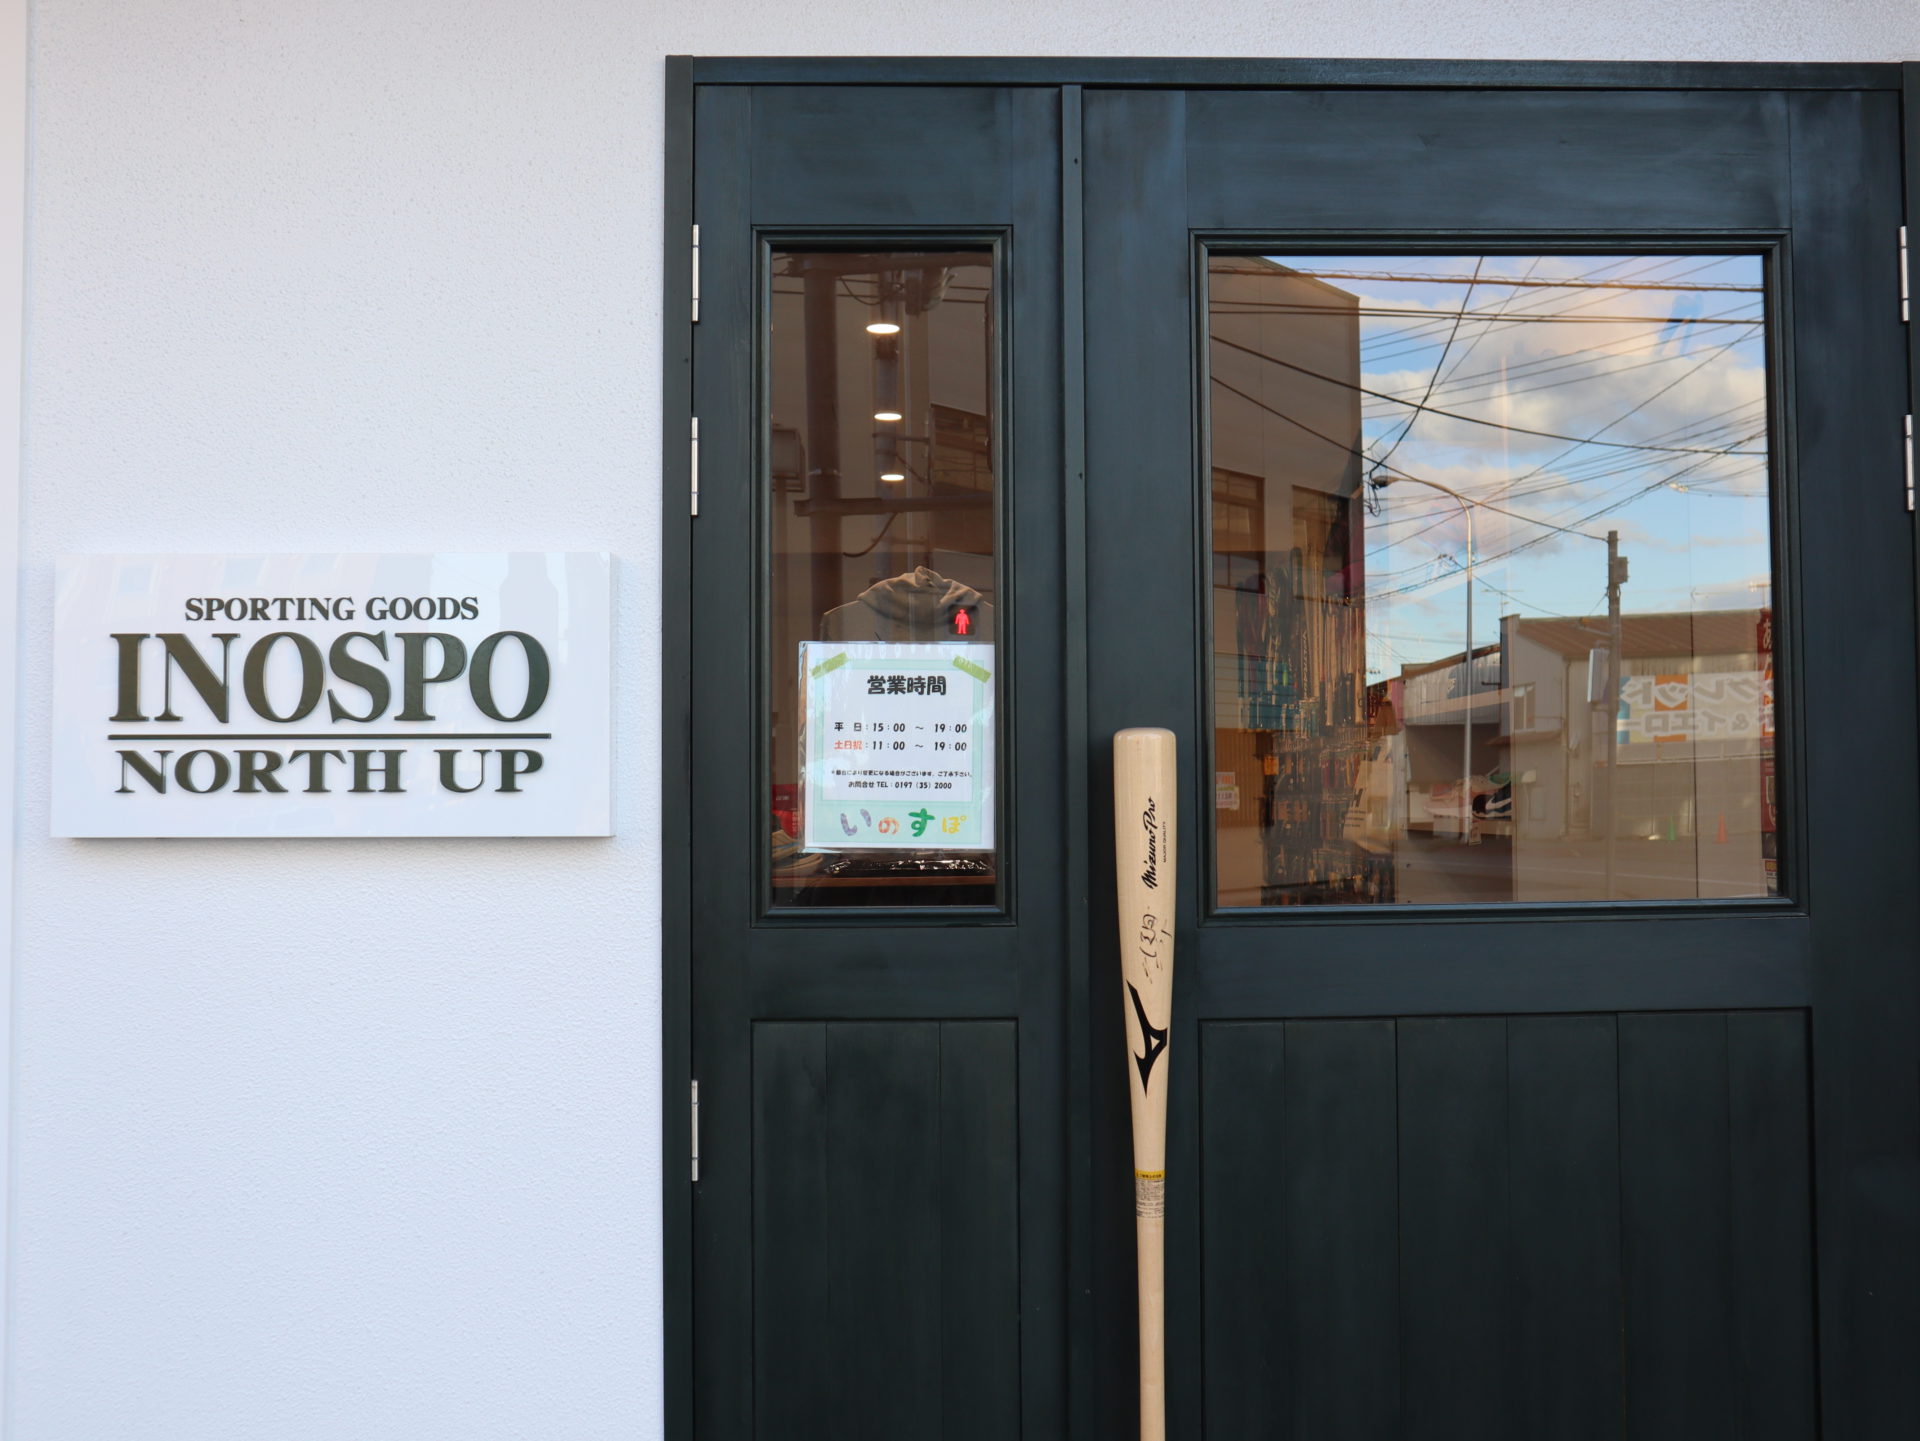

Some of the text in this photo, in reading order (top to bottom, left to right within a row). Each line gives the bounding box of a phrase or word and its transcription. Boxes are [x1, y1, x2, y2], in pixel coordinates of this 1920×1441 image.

[185, 597, 479, 621] SPORTING GOODS
[109, 630, 550, 724] INOSPO
[867, 675, 947, 696] 営業時間
[115, 749, 544, 794] NORTH UP
[840, 808, 968, 838] いのすぽ
[1143, 796, 1158, 831] Pro
[1141, 829, 1158, 890] Mizuno
